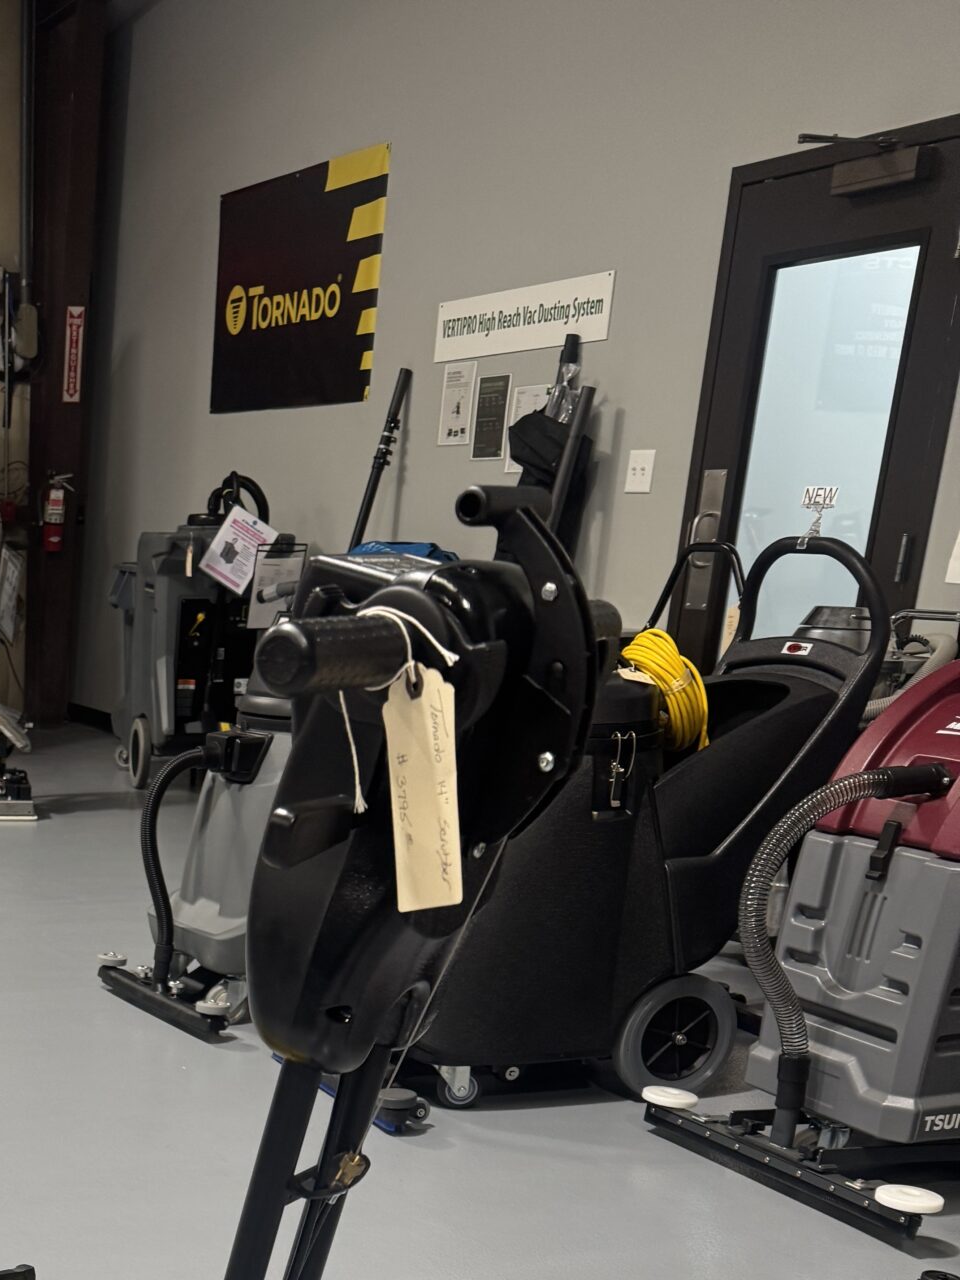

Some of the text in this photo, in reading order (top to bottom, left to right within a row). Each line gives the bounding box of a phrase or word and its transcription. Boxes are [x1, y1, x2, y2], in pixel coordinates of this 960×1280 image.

[248, 283, 341, 330] TORNADO
[442, 297, 604, 339] VERTIPRO High Reach Vac Dusting System
[803, 487, 838, 504] NEW
